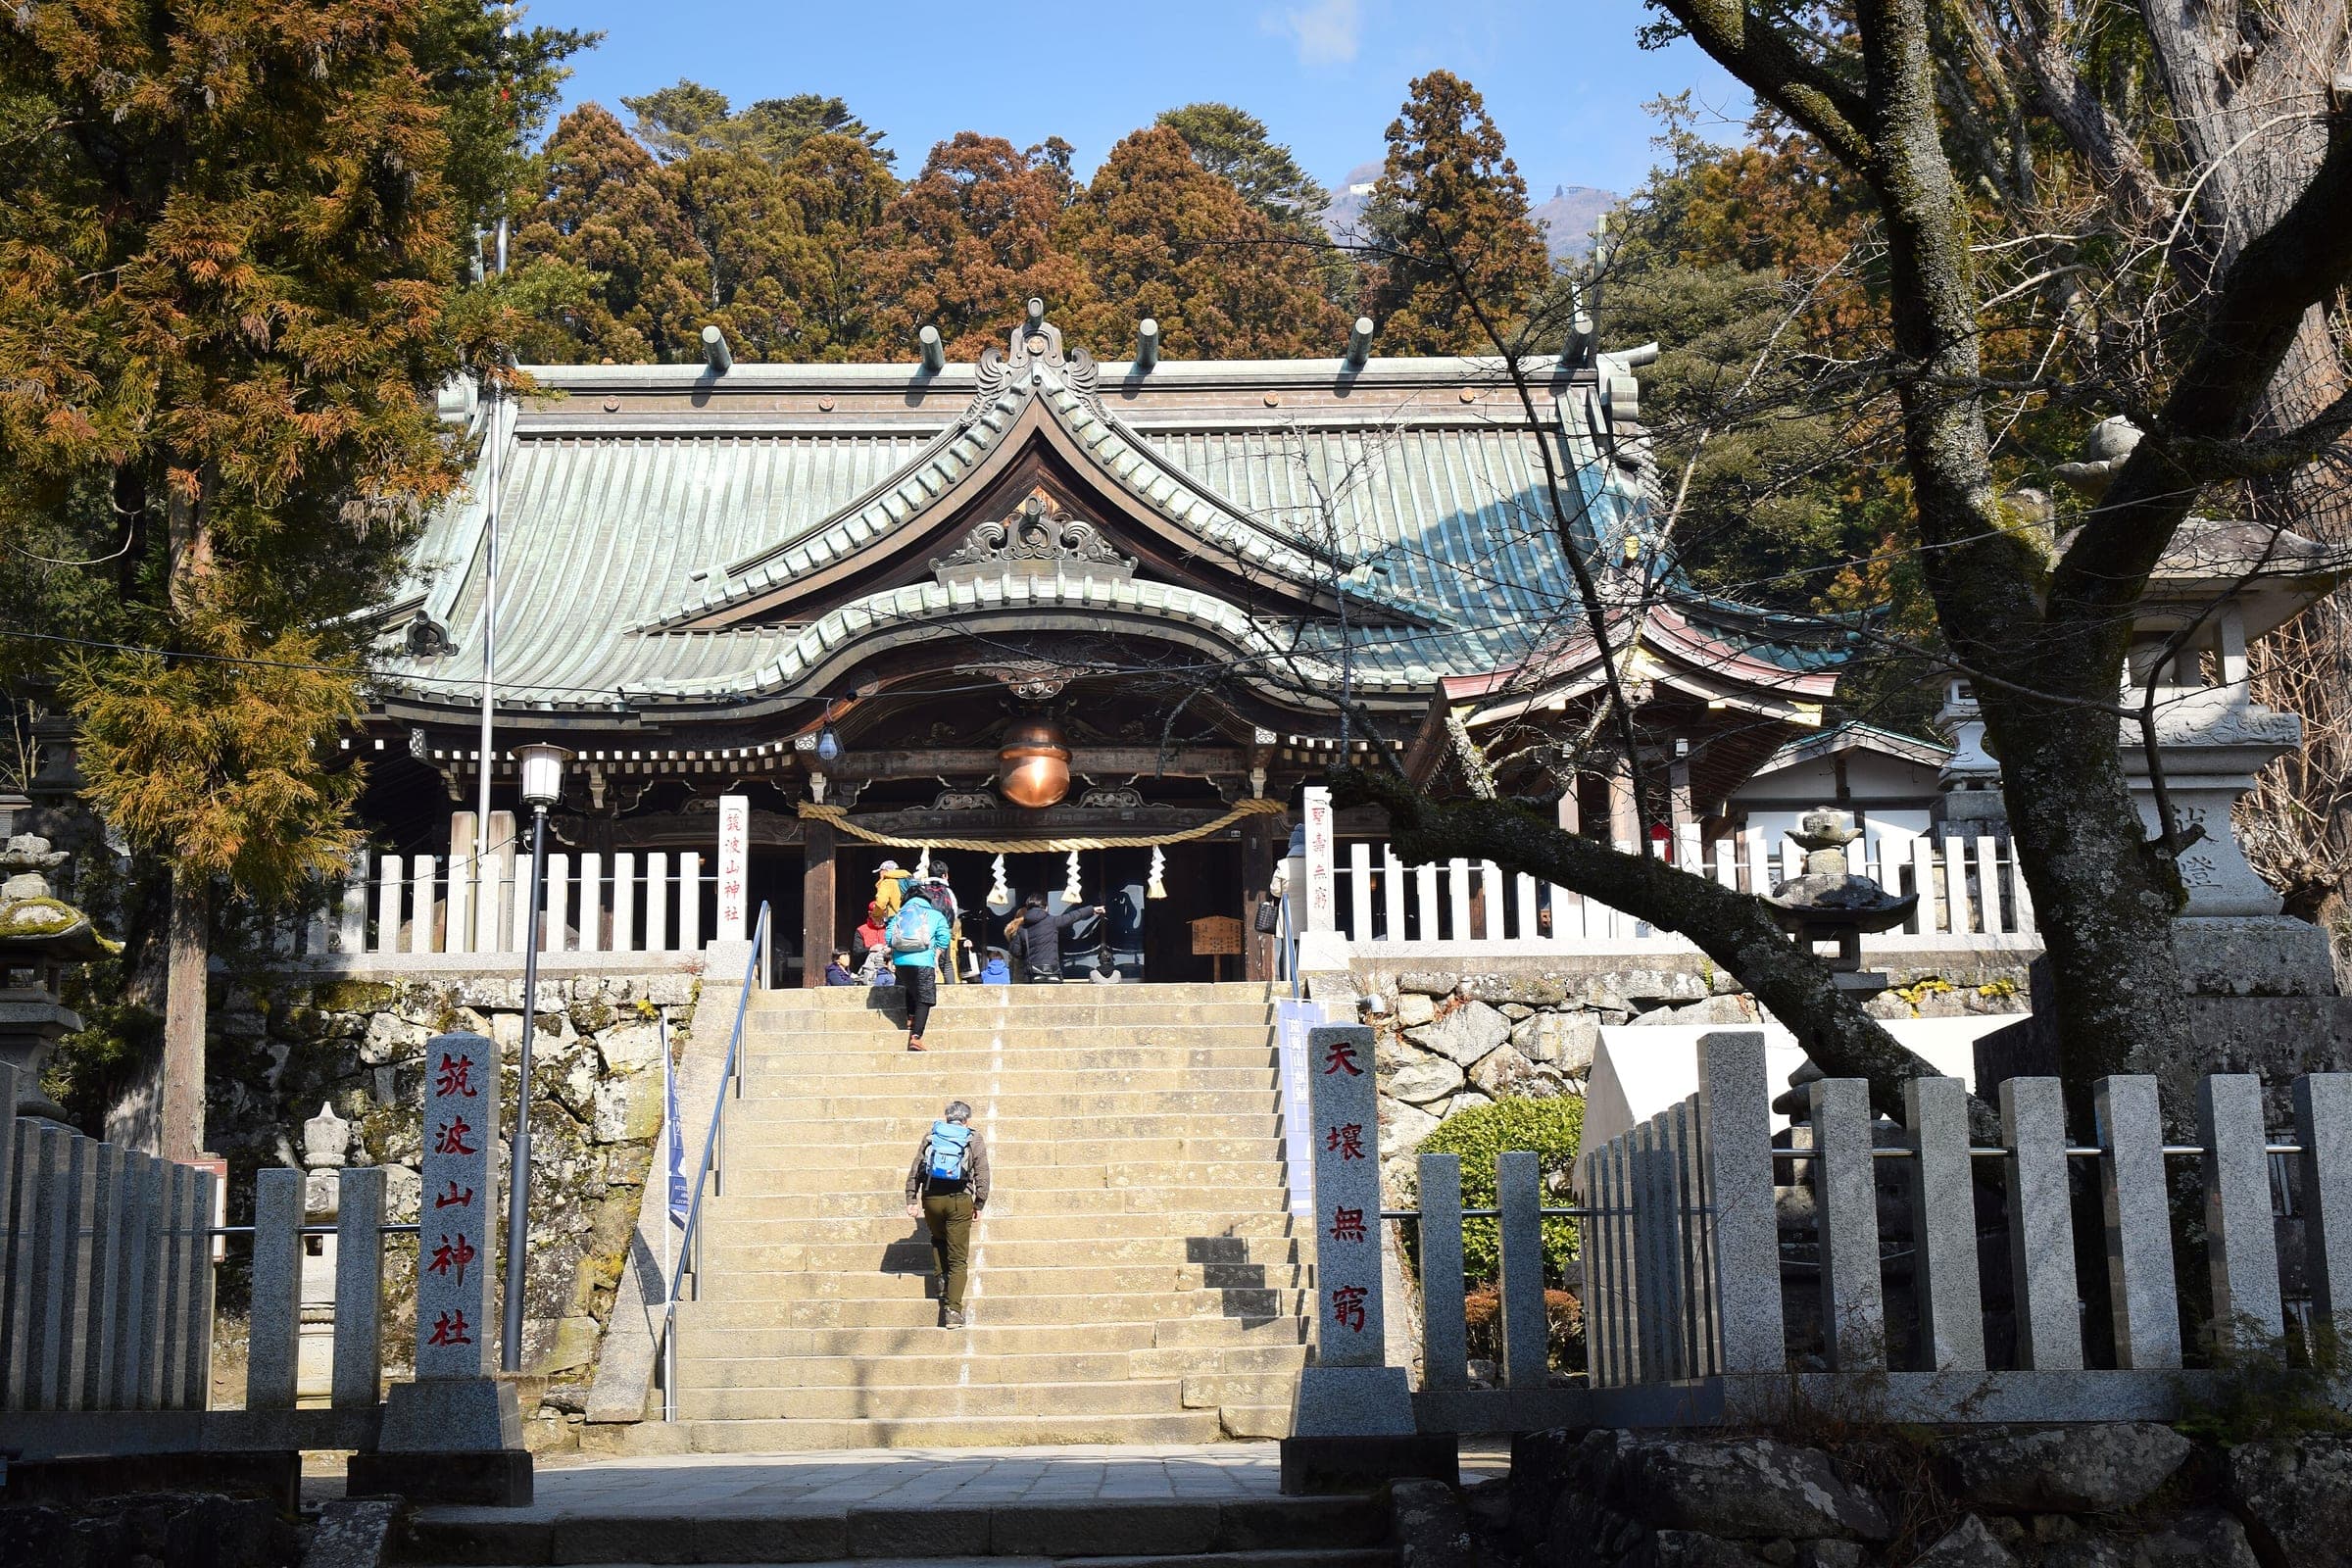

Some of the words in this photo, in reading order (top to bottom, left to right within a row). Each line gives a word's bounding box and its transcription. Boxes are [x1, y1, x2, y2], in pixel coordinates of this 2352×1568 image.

[723, 812, 742, 922] 筑波山神社
[427, 1052, 478, 1348] 筑波山神社
